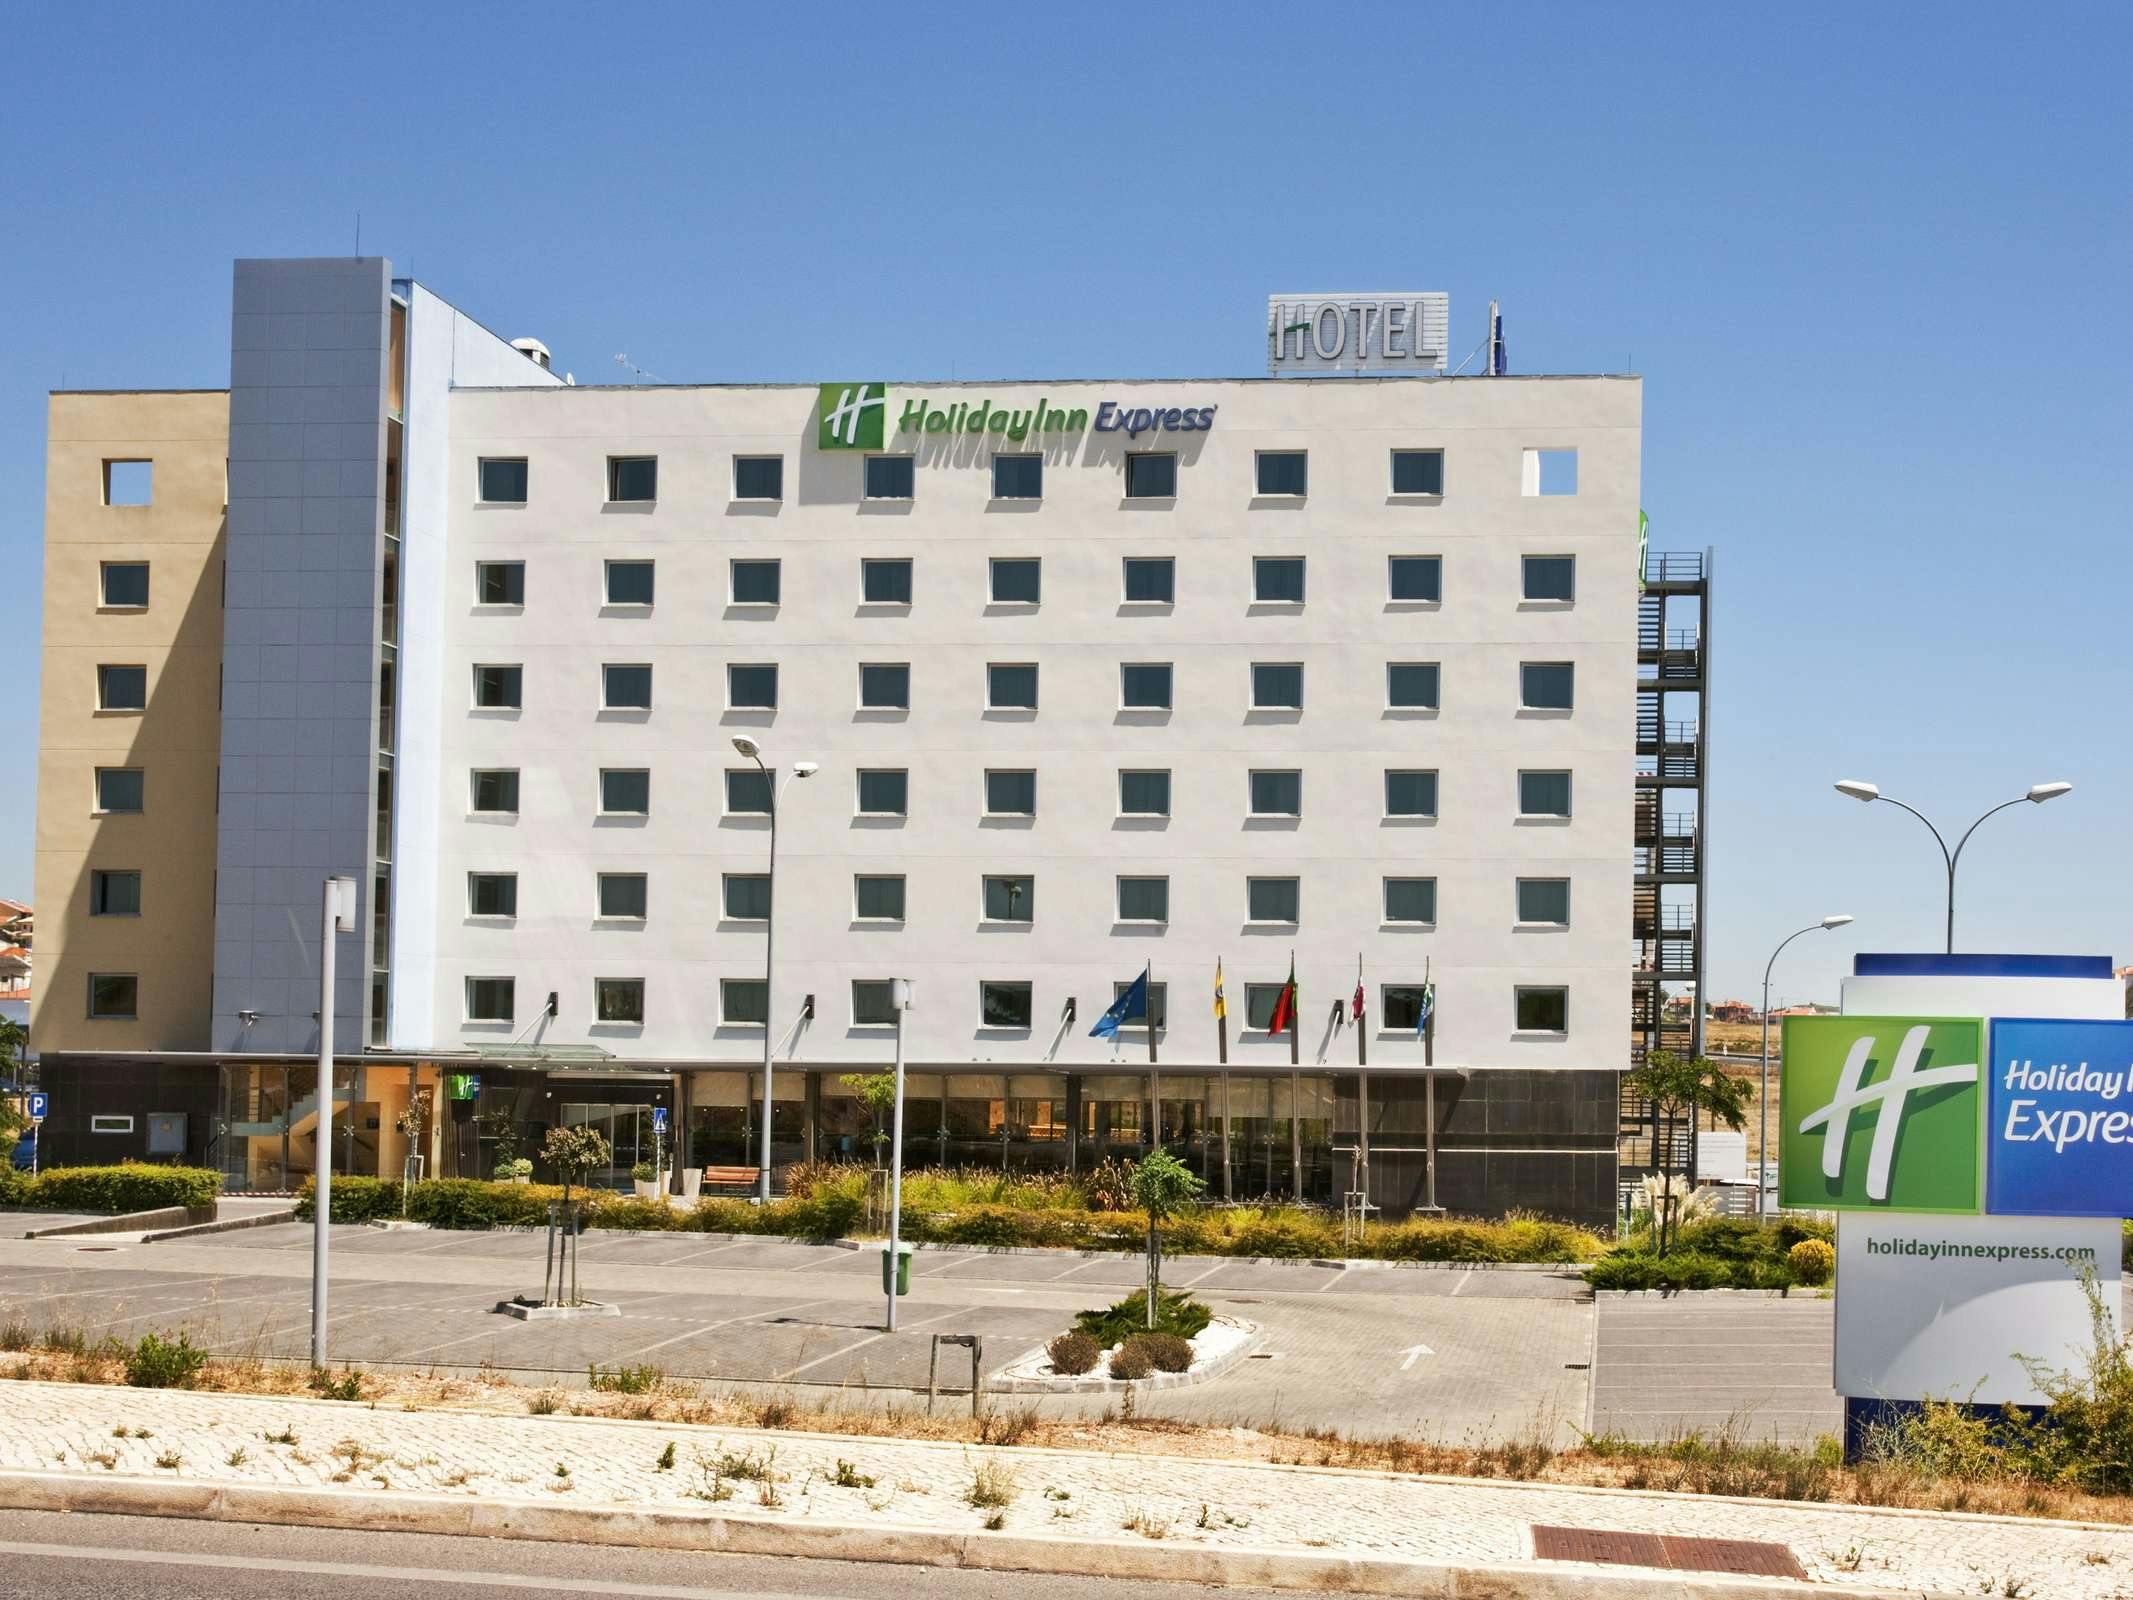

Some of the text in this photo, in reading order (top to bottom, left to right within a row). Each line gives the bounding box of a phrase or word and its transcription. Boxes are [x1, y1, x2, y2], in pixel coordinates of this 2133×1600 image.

[1270, 302, 1438, 360] HOTEL
[1094, 401, 1217, 440] Express
[2003, 1060, 2124, 1100] Holiday
[33, 1096, 44, 1114] P
[1867, 1237, 2095, 1262] holidayinnexpress.com
